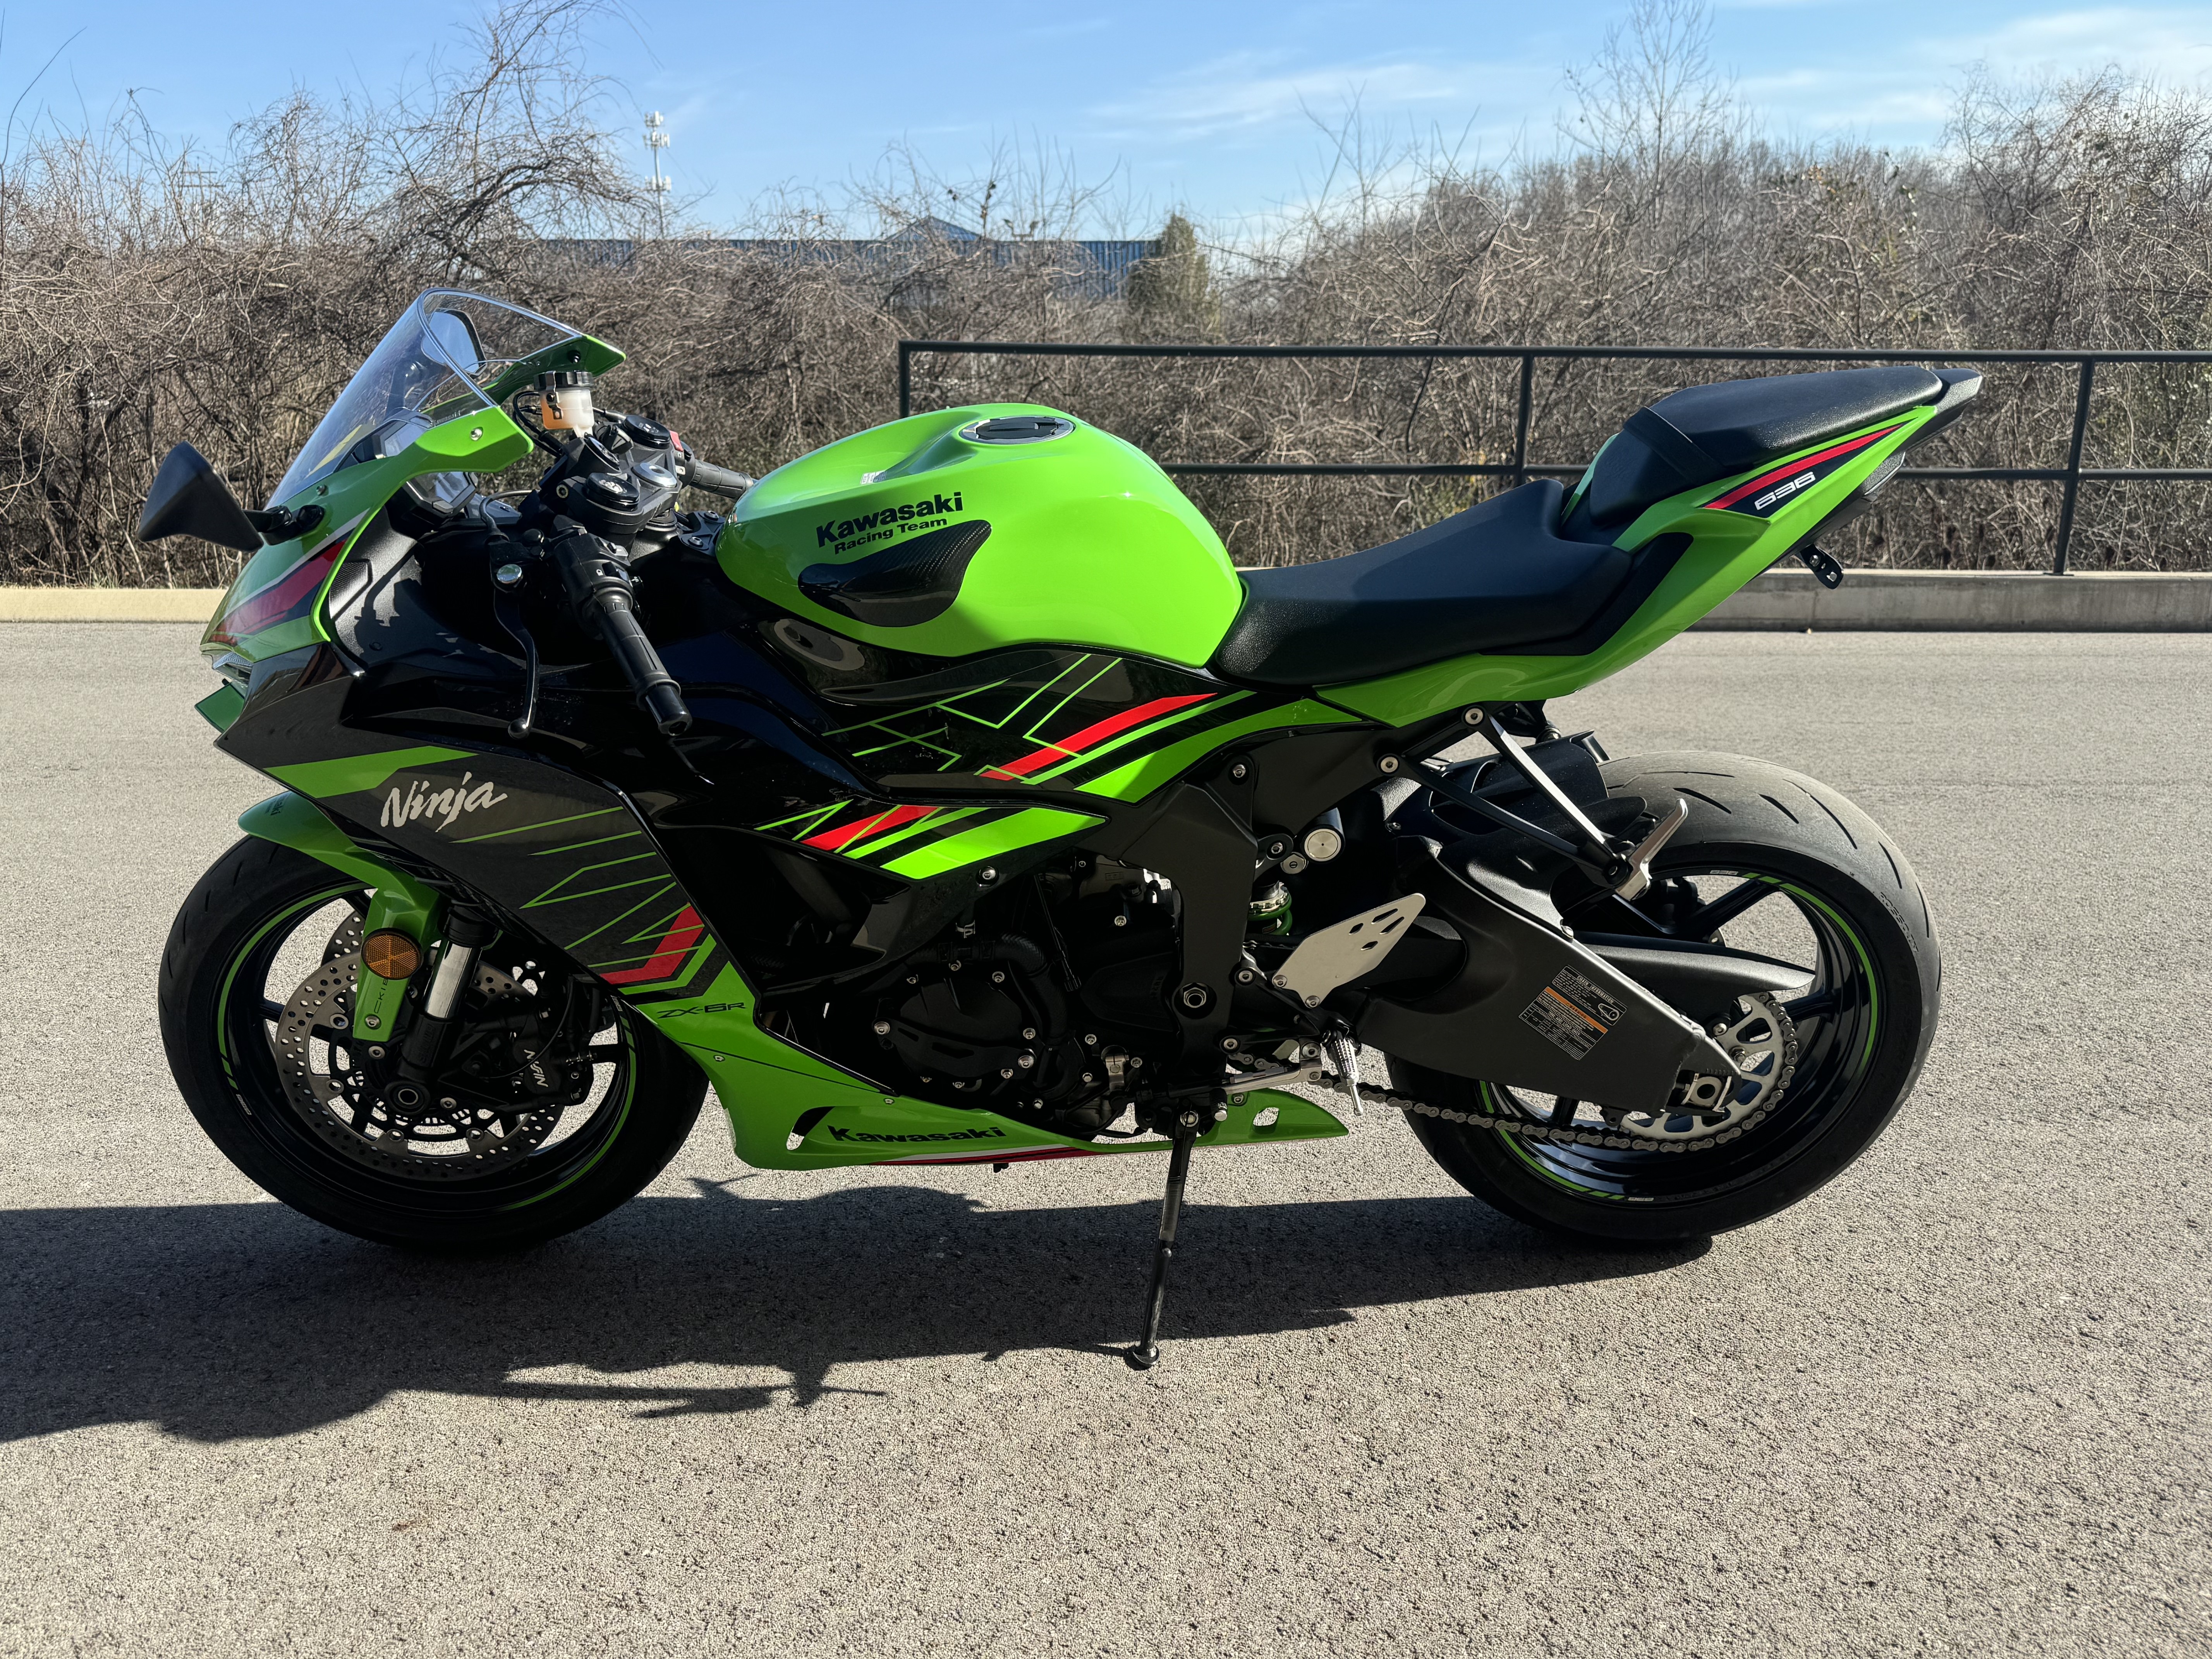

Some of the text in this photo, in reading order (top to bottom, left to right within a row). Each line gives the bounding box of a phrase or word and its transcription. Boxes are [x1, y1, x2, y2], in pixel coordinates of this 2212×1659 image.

[1754, 471, 1816, 510] 636
[816, 491, 963, 548] Kawasaki
[834, 518, 947, 555] Racing Team
[381, 771, 508, 833] Ninja
[656, 1001, 746, 1020] ZX-6R
[827, 1125, 1007, 1142] Kawasaki
